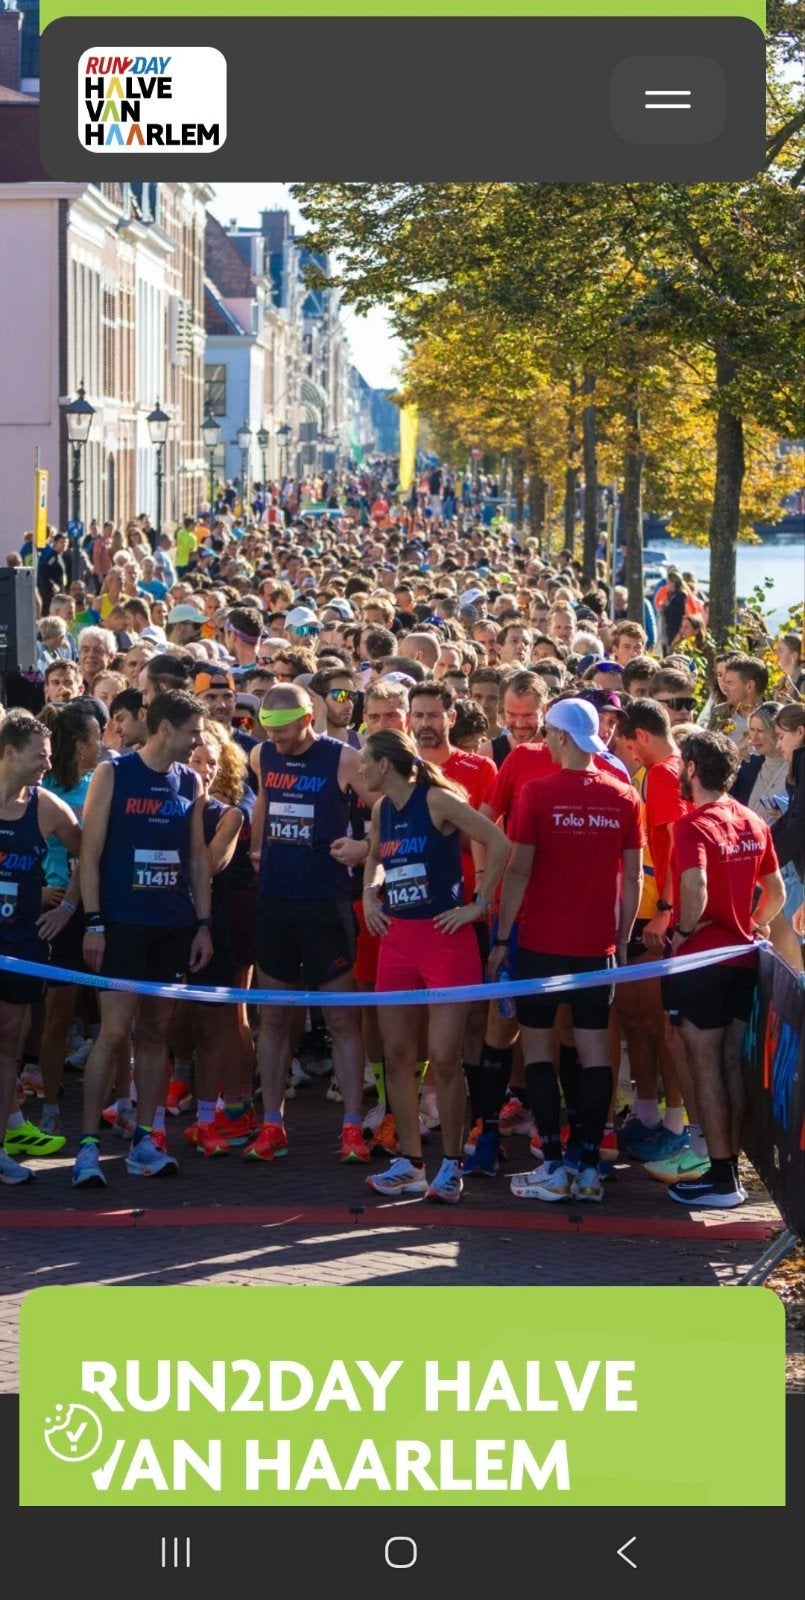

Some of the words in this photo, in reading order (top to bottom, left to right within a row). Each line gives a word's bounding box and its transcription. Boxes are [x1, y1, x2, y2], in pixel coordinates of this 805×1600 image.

[552, 813, 585, 827] Toko
[588, 814, 620, 829] Nina
[270, 822, 311, 839] 11414
[136, 870, 178, 886] 11413
[387, 884, 428, 905] 11421
